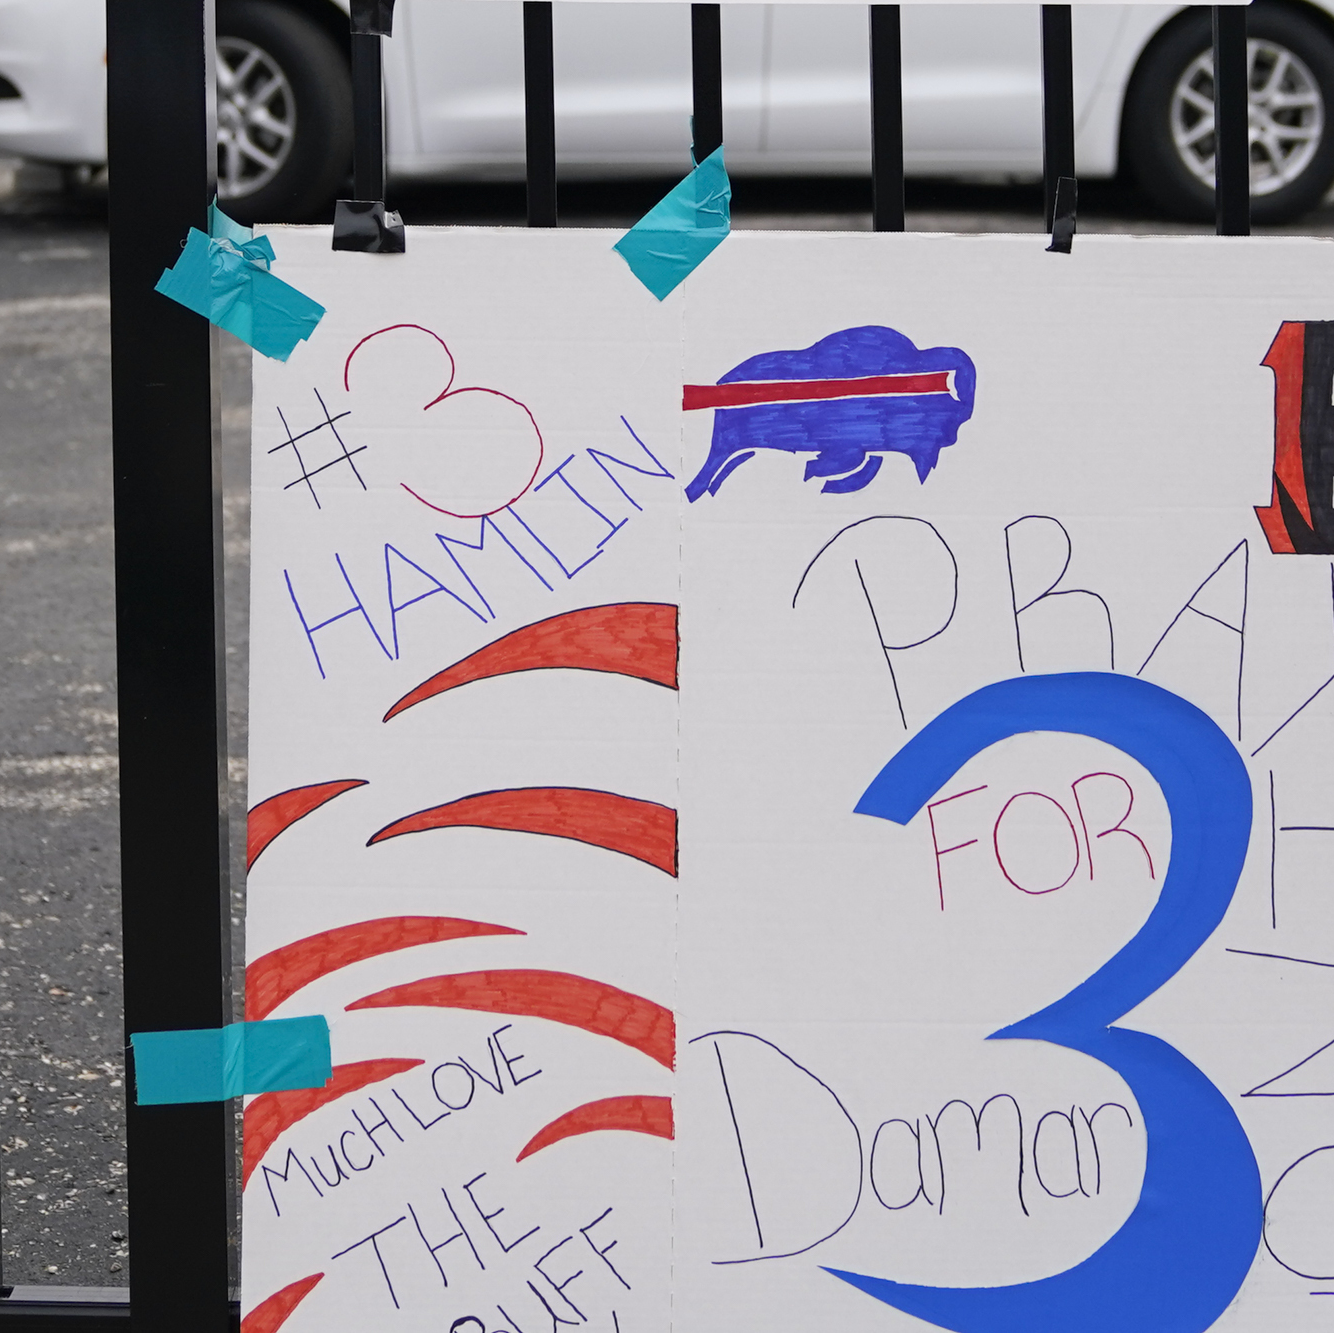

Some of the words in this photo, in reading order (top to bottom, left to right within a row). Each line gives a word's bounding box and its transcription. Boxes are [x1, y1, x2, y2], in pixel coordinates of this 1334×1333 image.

[267, 323, 544, 519] #3
[284, 415, 676, 679] HAMLIN
[927, 772, 1156, 911] FOR
[391, 1024, 542, 1130] LOVE
[687, 1030, 1133, 1266] Damar
[331, 1172, 540, 1309] THE
